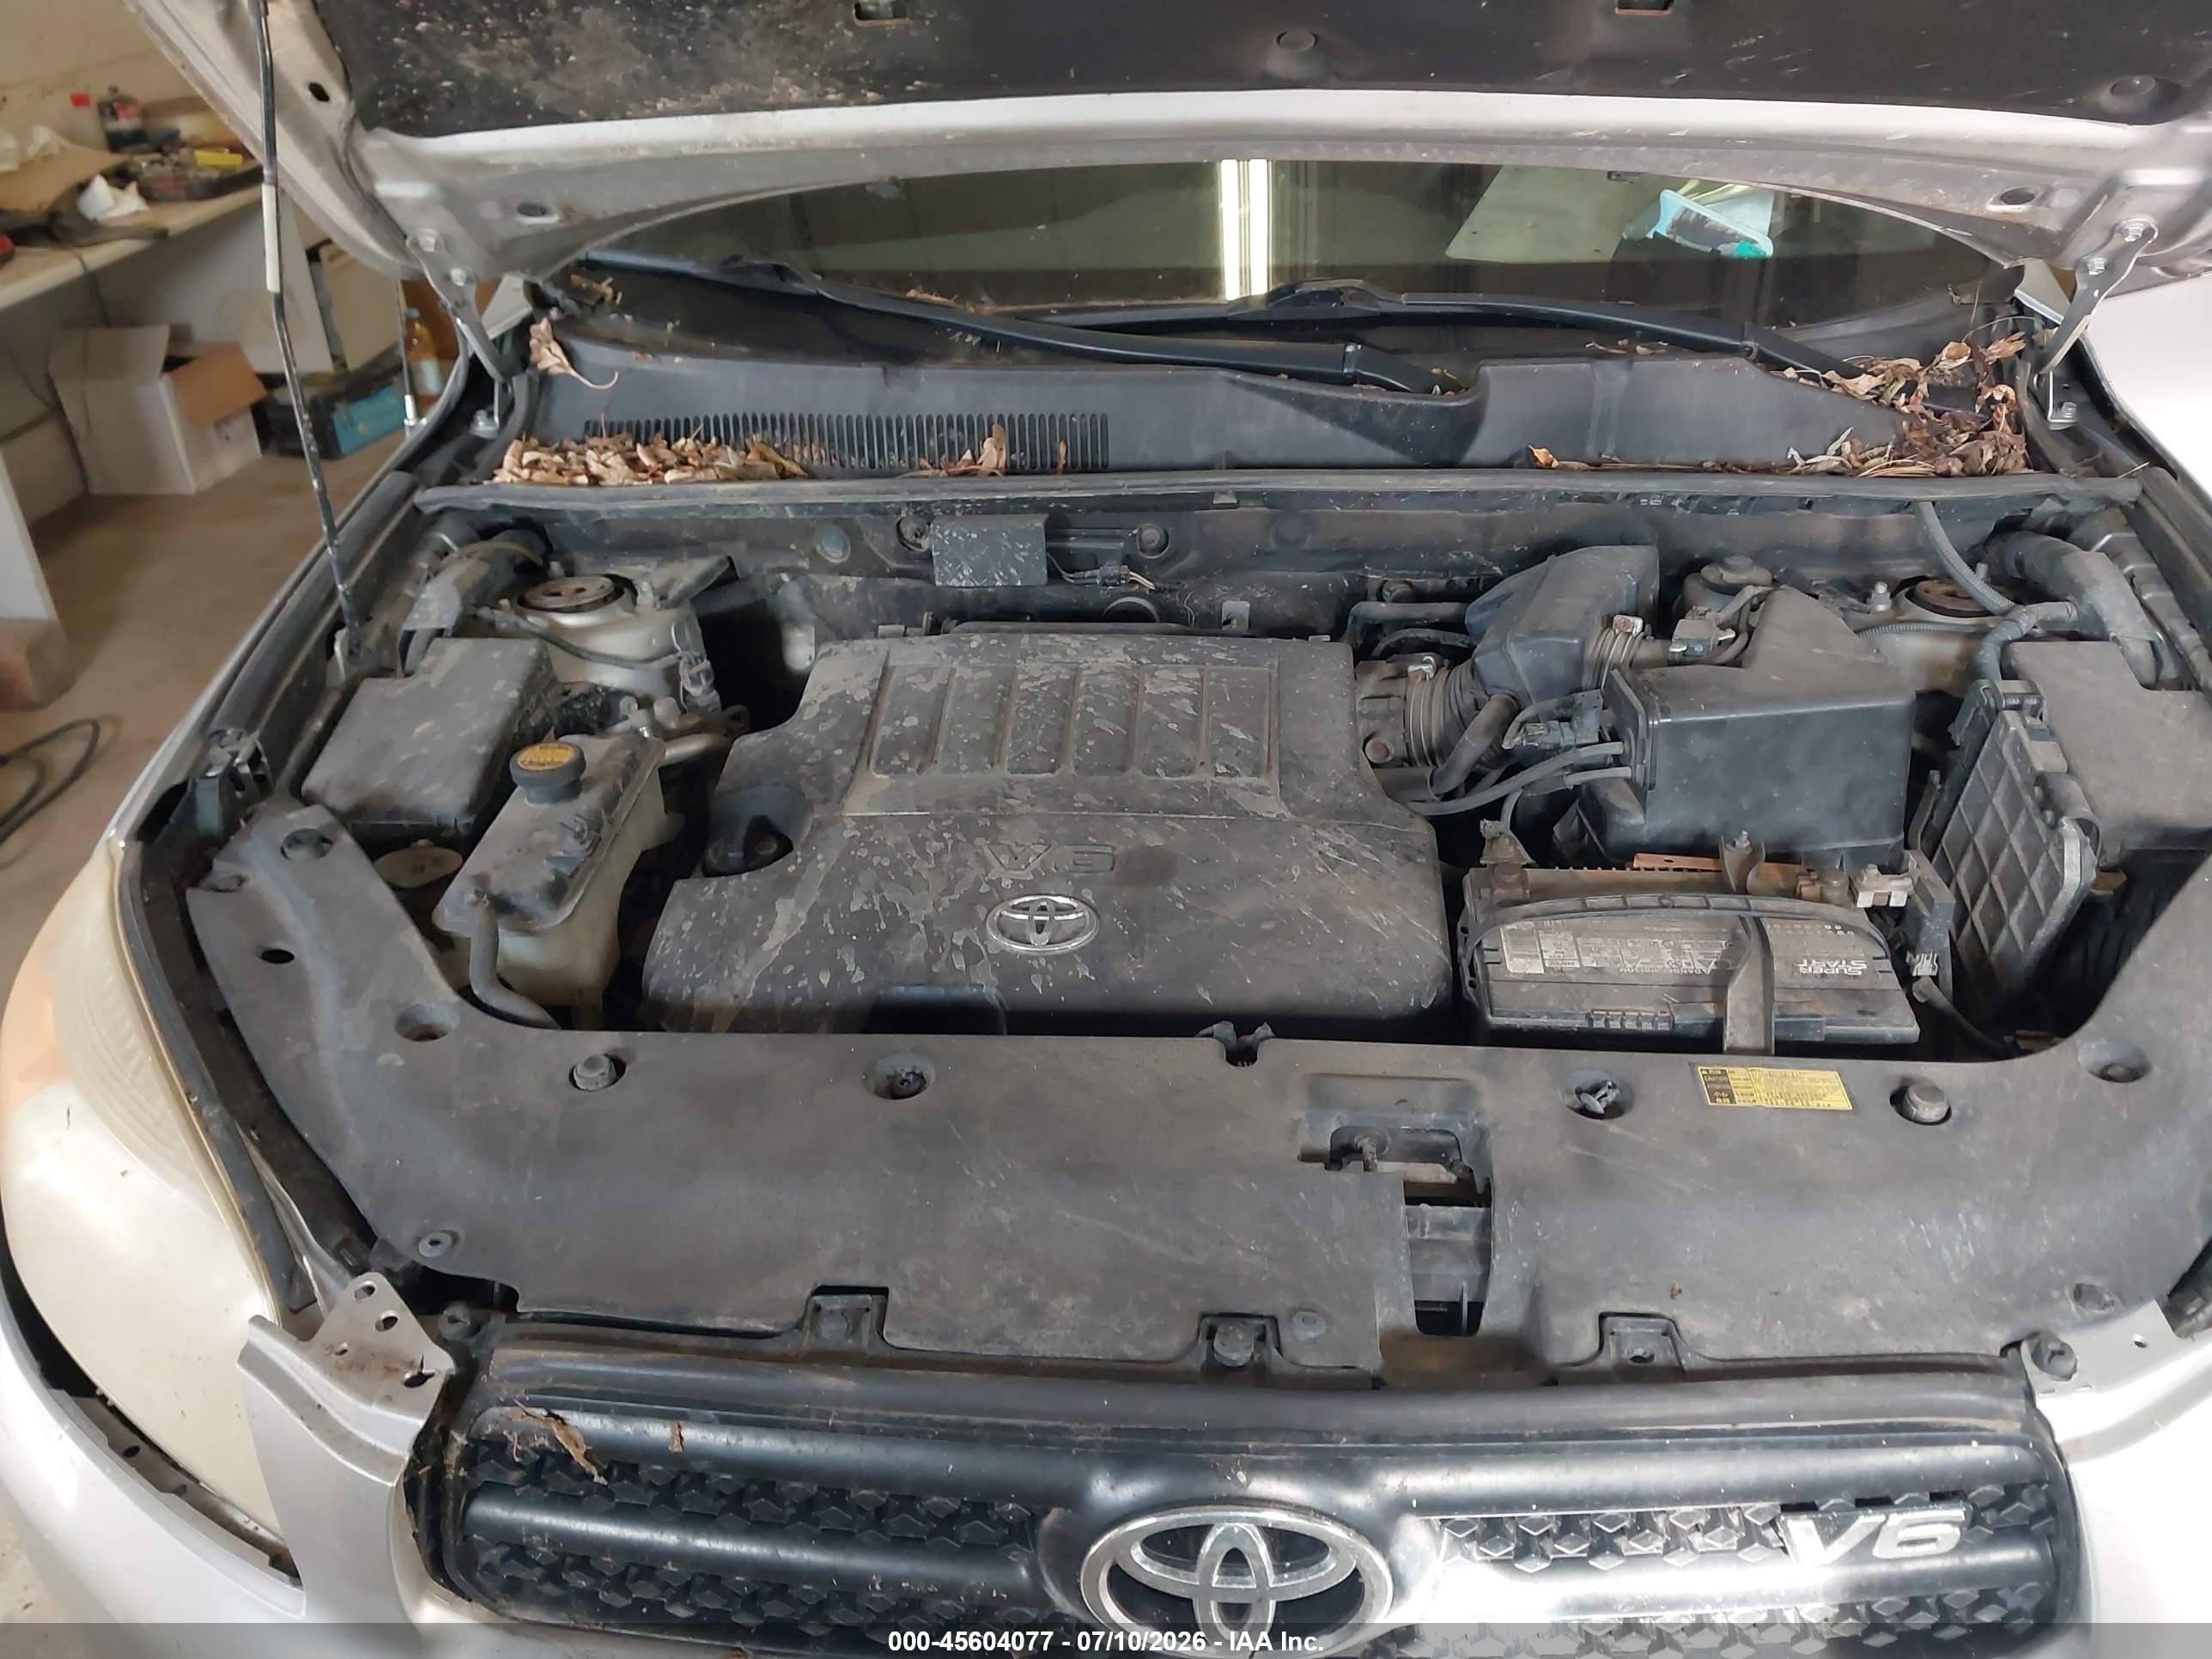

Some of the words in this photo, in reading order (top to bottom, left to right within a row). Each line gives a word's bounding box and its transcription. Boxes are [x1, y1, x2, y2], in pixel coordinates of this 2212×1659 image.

[1793, 959, 1868, 969] START
[1799, 966, 1863, 975] SUPER
[1786, 1509, 1966, 1565] V6
